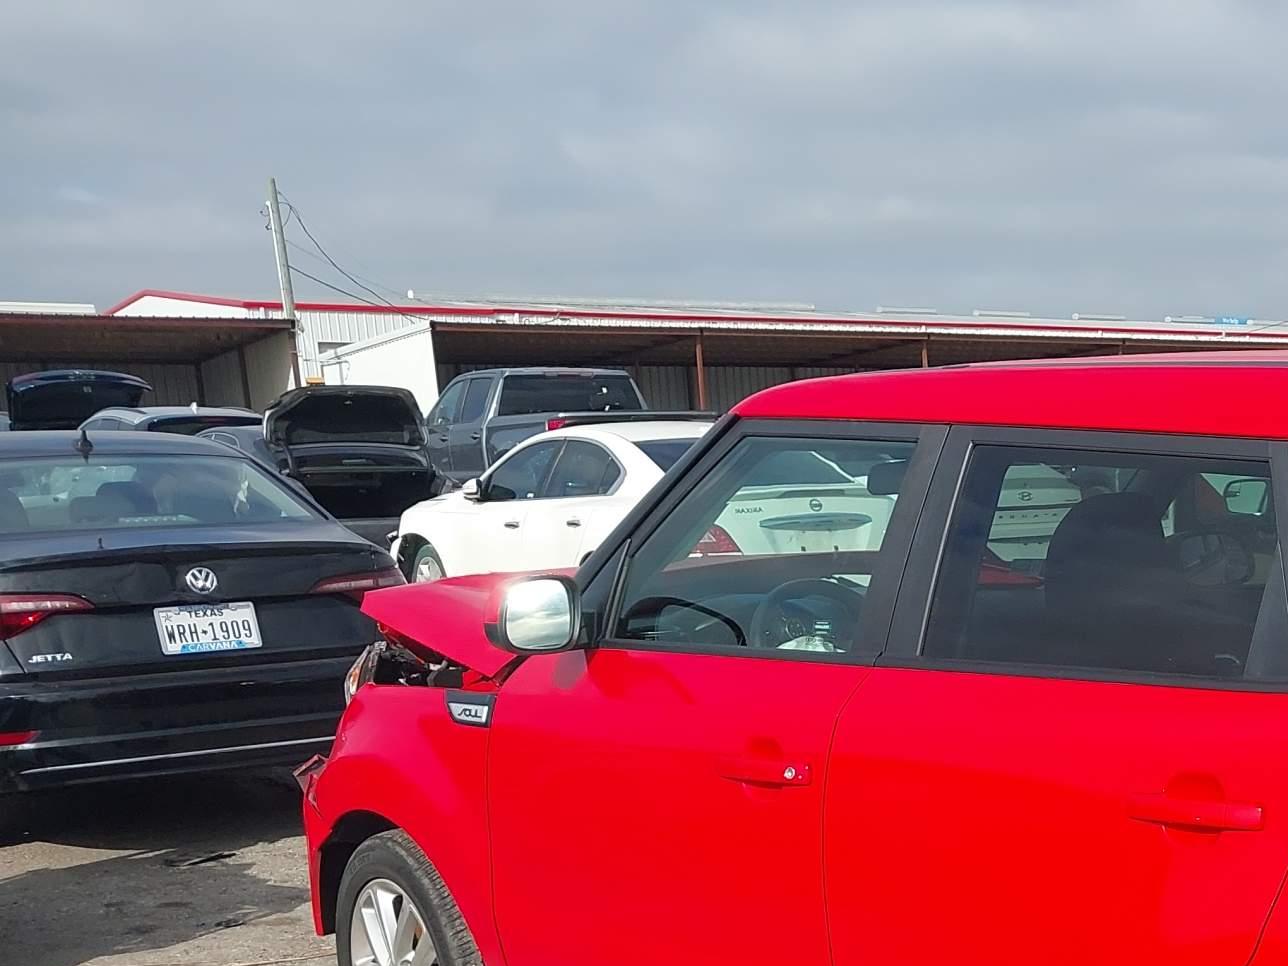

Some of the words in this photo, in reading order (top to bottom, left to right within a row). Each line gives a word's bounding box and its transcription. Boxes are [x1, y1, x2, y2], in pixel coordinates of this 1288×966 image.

[187, 608, 224, 619] TEXAS
[208, 619, 253, 642] 1909
[187, 640, 239, 652] CARVANA
[28, 653, 73, 663] JETTA
